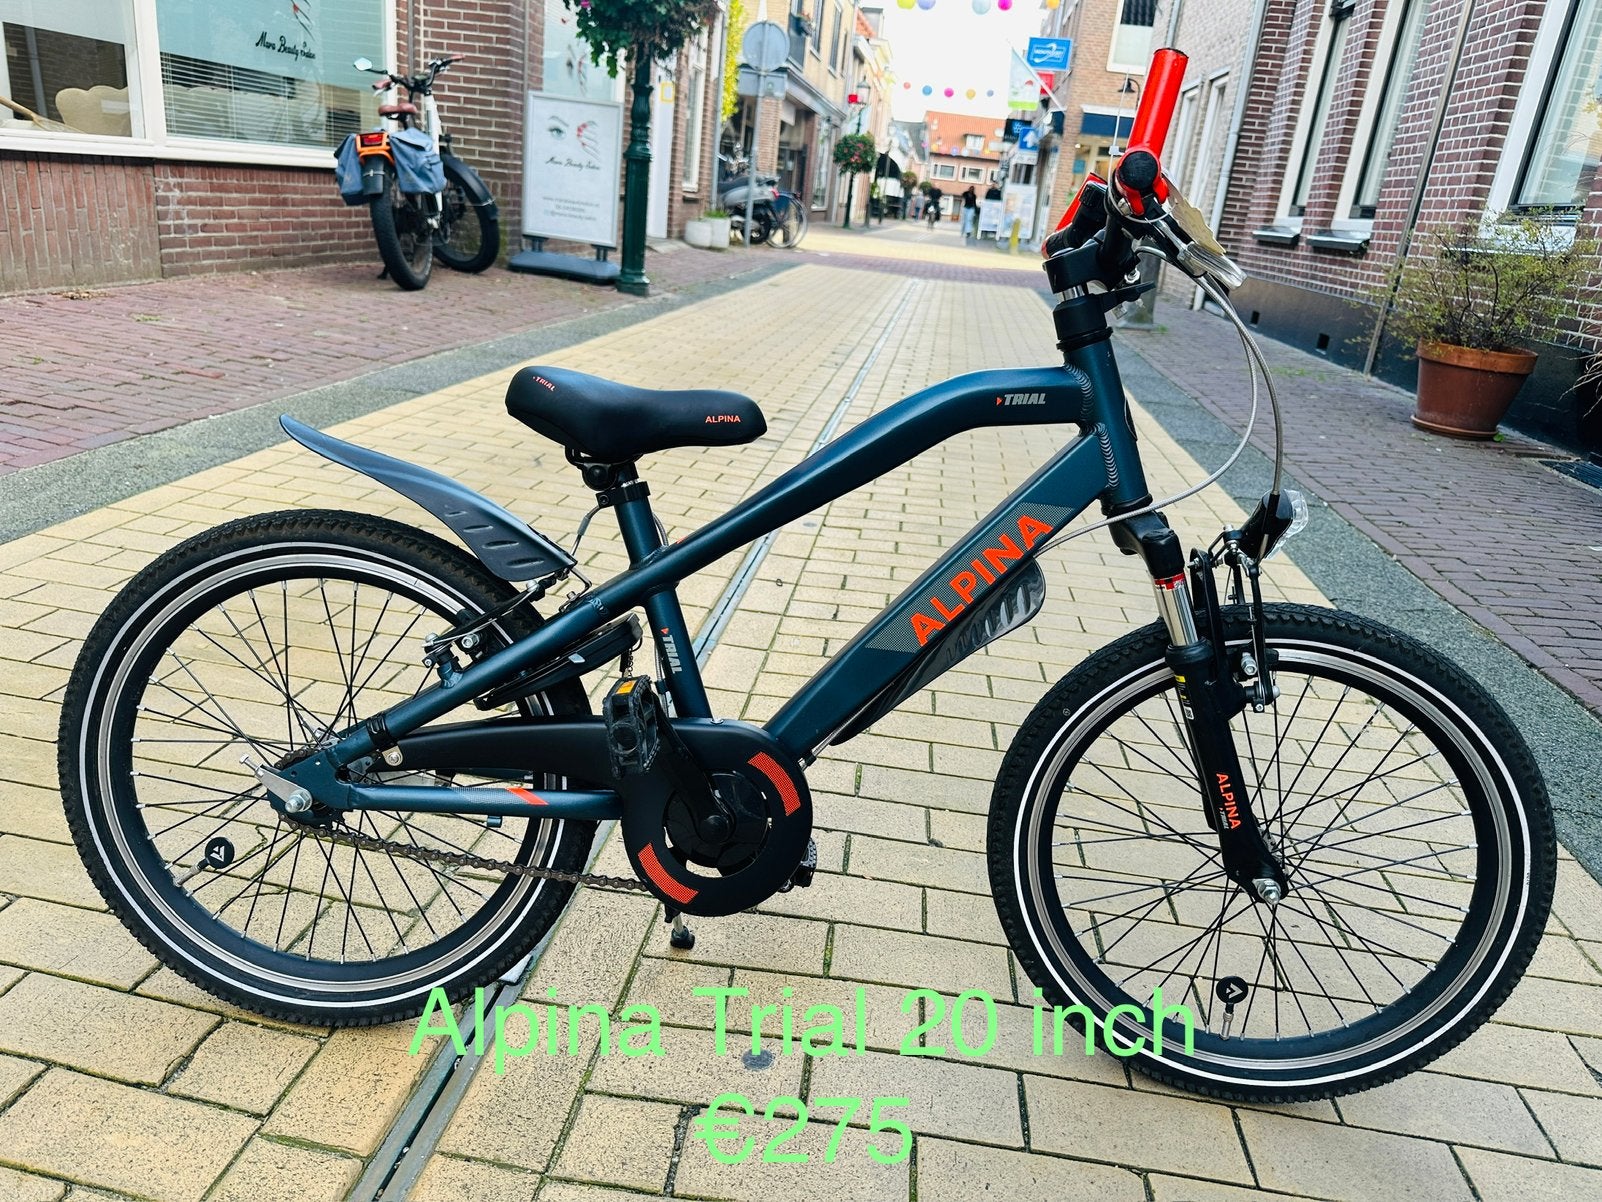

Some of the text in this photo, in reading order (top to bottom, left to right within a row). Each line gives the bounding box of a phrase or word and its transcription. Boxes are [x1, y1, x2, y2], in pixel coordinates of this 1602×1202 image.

[277, 35, 299, 61] Beauty
[535, 376, 555, 391] TRIAL
[1004, 393, 1046, 405] TRIAL
[705, 415, 741, 423] ALPINA
[910, 514, 1054, 647] ALPINA
[662, 635, 682, 674] TRIAL
[1216, 773, 1241, 829] ALPINA
